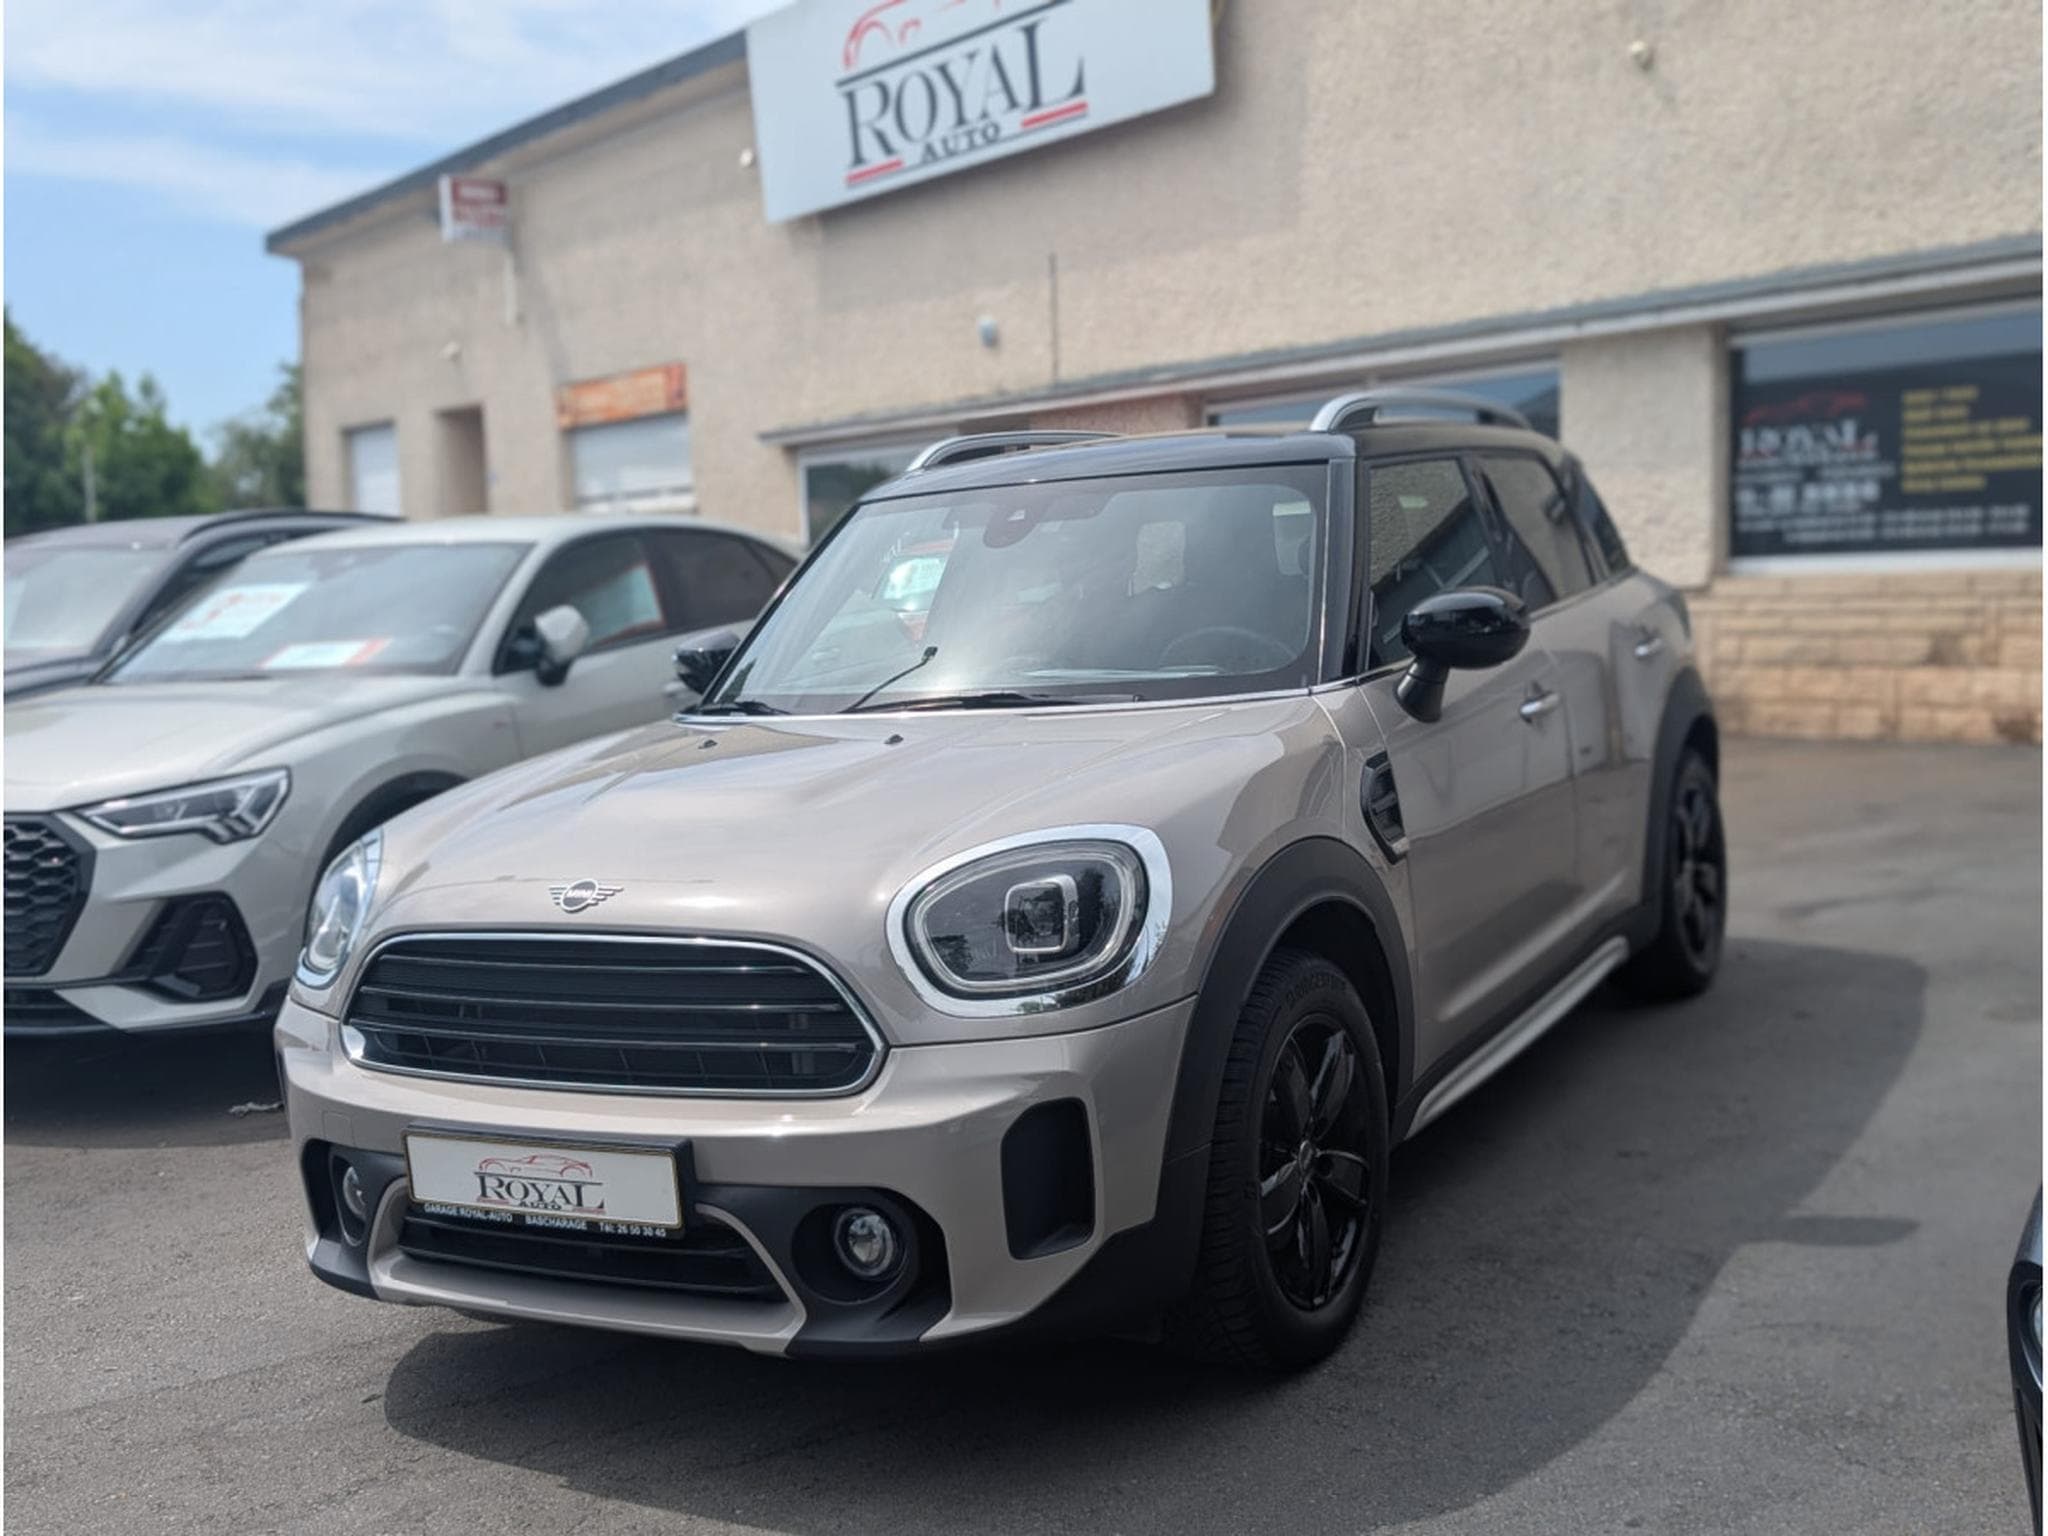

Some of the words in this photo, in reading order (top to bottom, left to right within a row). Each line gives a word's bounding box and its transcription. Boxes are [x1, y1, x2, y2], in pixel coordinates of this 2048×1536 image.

[842, 18, 1086, 168] ROYAL
[920, 121, 1001, 165] AUTO
[477, 1175, 605, 1209] ROYAL
[519, 1200, 562, 1211] AUTO
[424, 1202, 458, 1217] GARAGE
[460, 1206, 513, 1223] ROYAL-AUTO
[525, 1214, 588, 1231] BASCHARAGE
[617, 1224, 629, 1235] 26
[630, 1225, 641, 1236] 50
